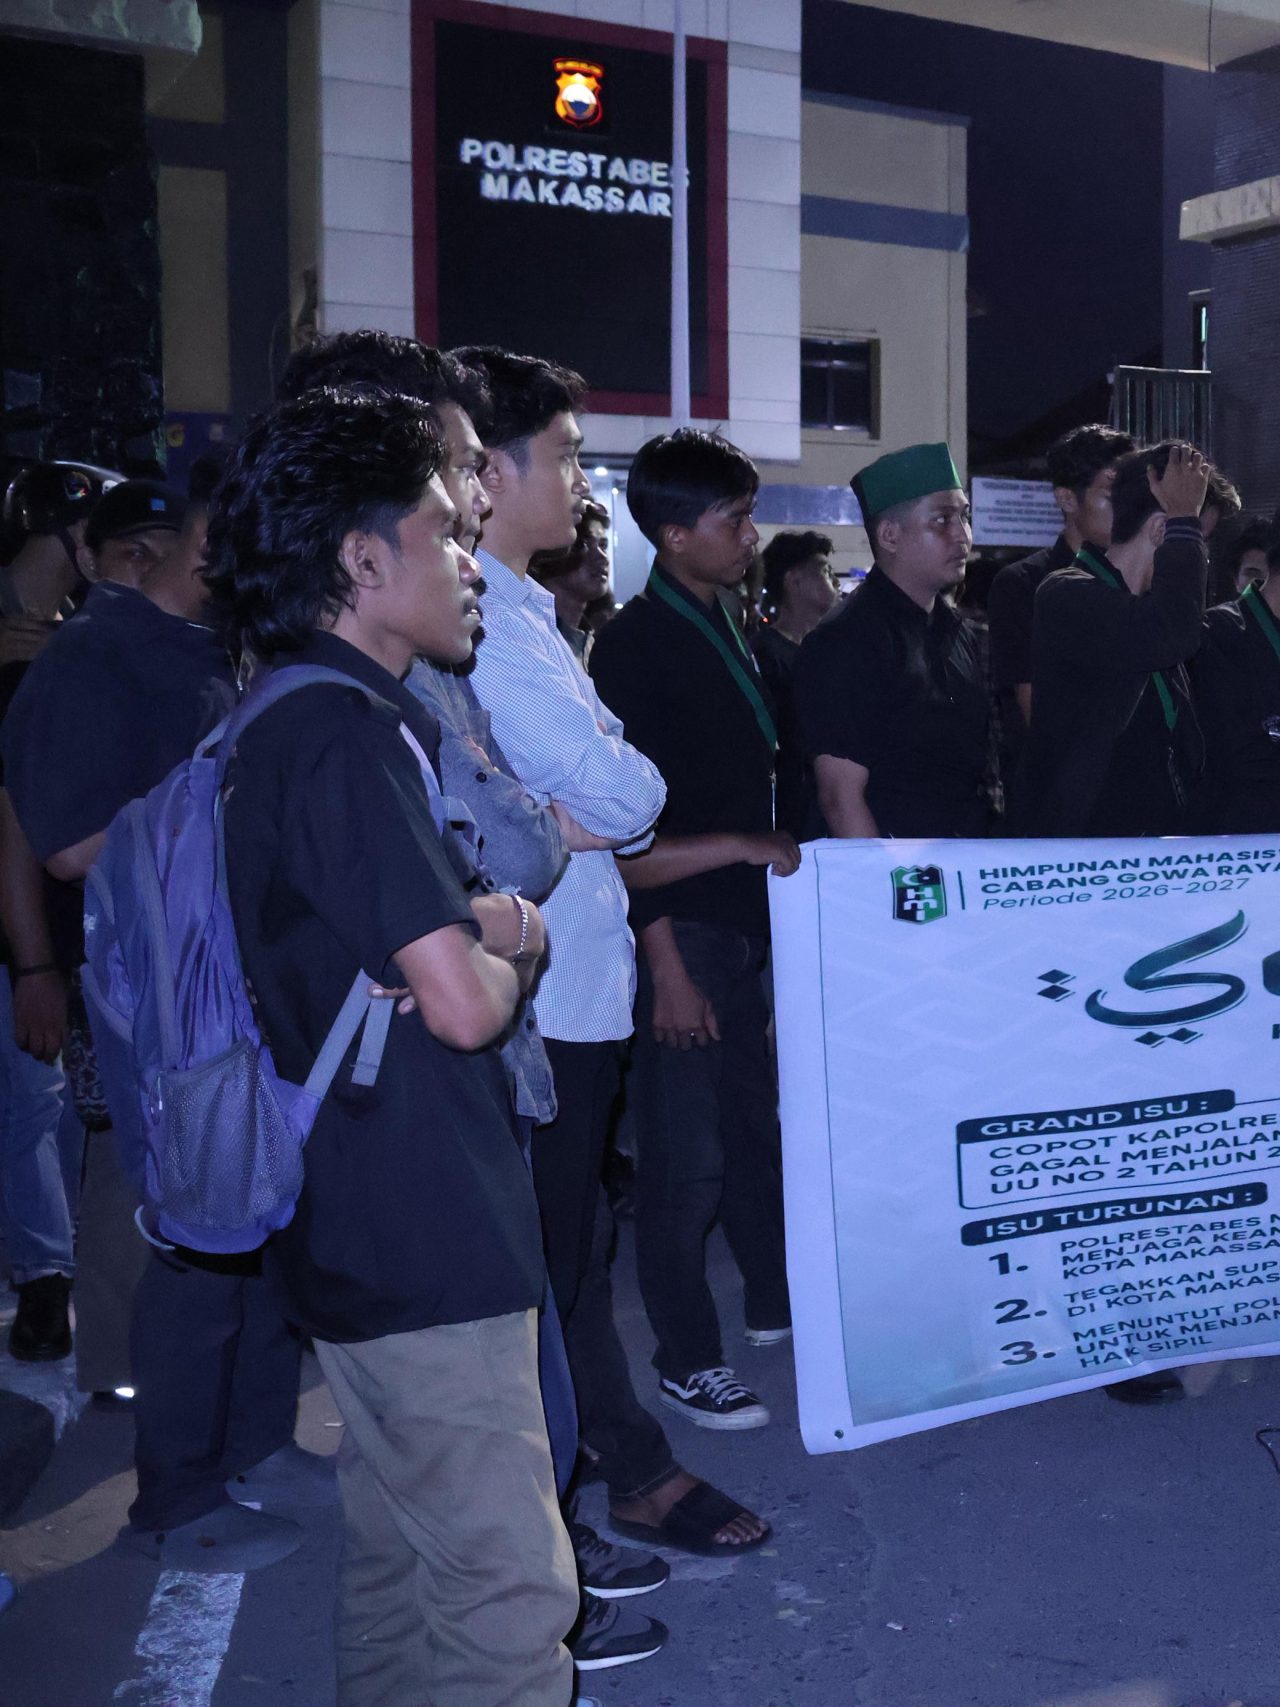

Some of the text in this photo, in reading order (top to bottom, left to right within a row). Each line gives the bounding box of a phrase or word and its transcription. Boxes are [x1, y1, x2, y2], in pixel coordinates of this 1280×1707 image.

[481, 173, 672, 217] MAKASSAR
[979, 858, 1140, 880] HIMPUNAN
[981, 875, 1109, 895] CABANG
[1117, 867, 1210, 886] GOWA
[983, 878, 1250, 911] Periode 2026-2027
[981, 1111, 1122, 1136] GRAND
[1134, 1100, 1189, 1120] ISU
[989, 1136, 1117, 1160] COPOT
[989, 1154, 1110, 1177] GAGAL
[991, 1178, 1039, 1194] UU
[1052, 1170, 1105, 1186] NO
[1117, 1167, 1136, 1179] 2
[1147, 1150, 1257, 1175] TAHUN
[985, 1216, 1043, 1238] ISU
[1053, 1192, 1234, 1225] TURUNAN
[1060, 1217, 1260, 1252] POLRESTABES
[989, 1252, 1029, 1275] 1.
[1062, 1235, 1202, 1265] MENJAGA
[1063, 1258, 1135, 1279] KOTA
[1064, 1269, 1215, 1304] TEGAKKAN
[994, 1298, 1048, 1325] 2.
[1067, 1303, 1096, 1318] DI
[1106, 1290, 1175, 1309] KOTA
[1073, 1306, 1225, 1342] MENUNTUT
[1000, 1340, 1057, 1366] 3.
[1076, 1327, 1170, 1355] UNTUK
[1080, 1336, 1212, 1368] HAK SIPIL
